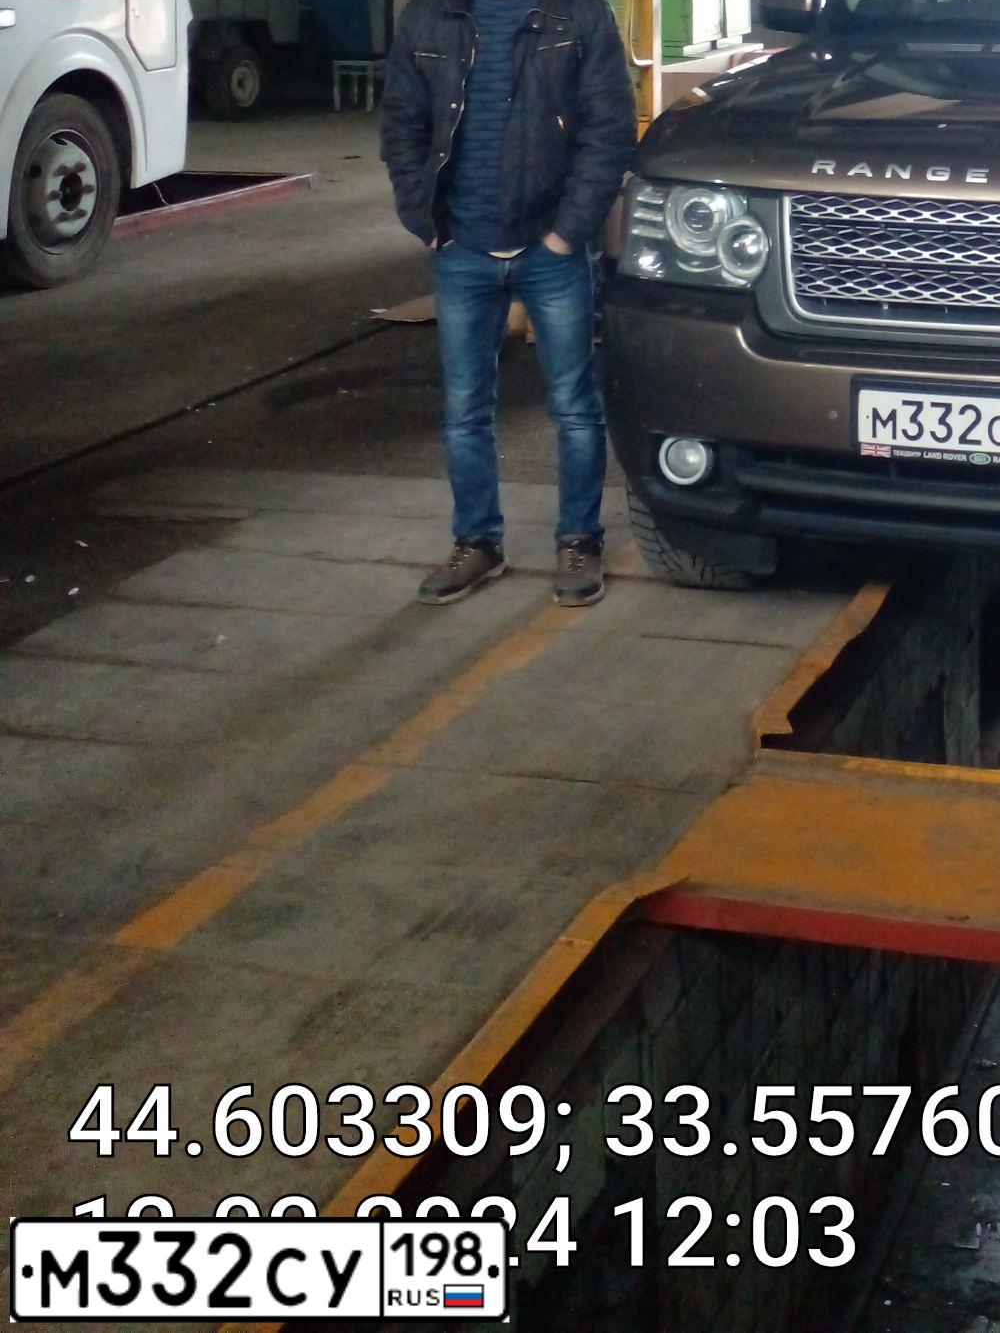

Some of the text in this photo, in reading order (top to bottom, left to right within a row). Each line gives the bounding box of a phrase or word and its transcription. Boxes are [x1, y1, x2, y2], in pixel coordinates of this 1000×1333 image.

[812, 159, 990, 184] RANGE
[923, 451, 942, 460] LAND
[943, 453, 967, 462] ROVER
